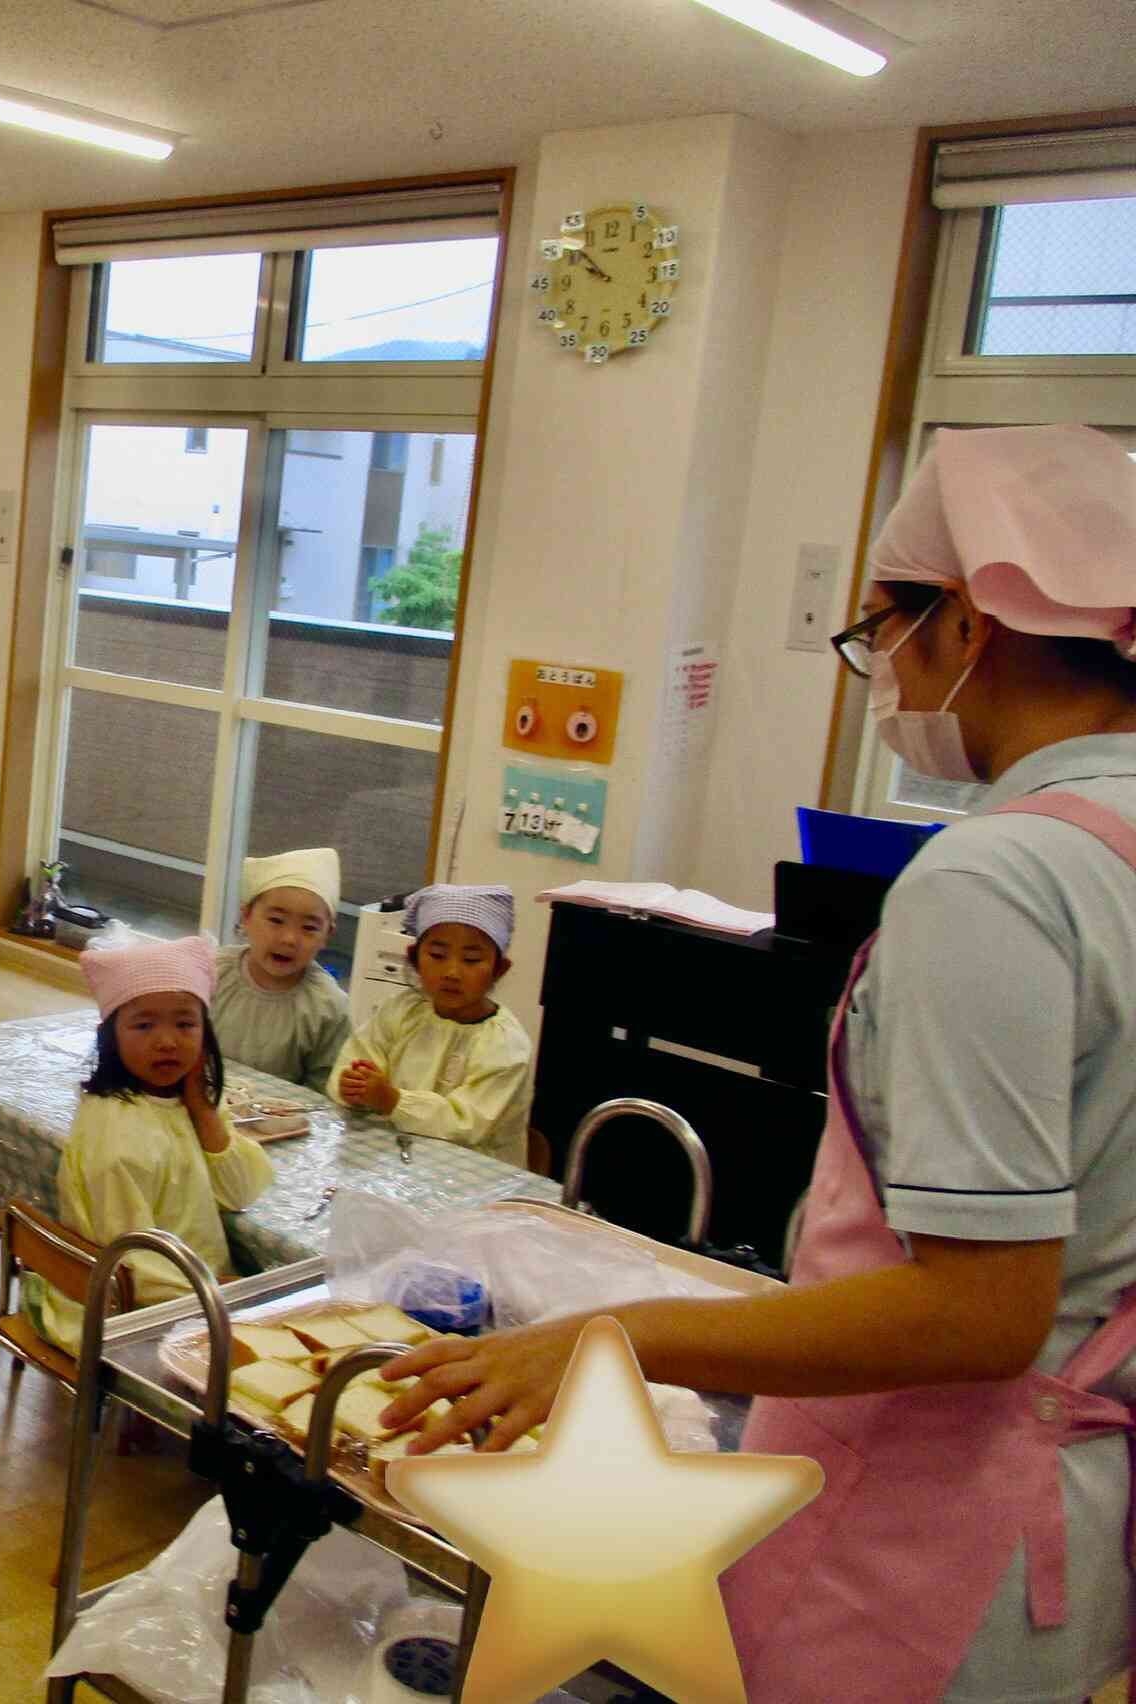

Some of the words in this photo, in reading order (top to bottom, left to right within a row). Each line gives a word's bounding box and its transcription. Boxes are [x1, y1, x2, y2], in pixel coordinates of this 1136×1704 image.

[636, 206, 646, 218] 5
[605, 220, 620, 238] 12
[630, 225, 637, 242] 1
[585, 231, 595, 246] 11
[643, 241, 653, 258] 2
[647, 266, 657, 283] 3
[662, 264, 677, 276] 15
[530, 278, 549, 290] 45
[560, 274, 572, 291] 9
[565, 299, 575, 314] 8
[638, 291, 647, 308] 4
[538, 310, 556, 321] 40
[652, 302, 669, 314] 20
[580, 316, 589, 332] 7
[622, 313, 632, 328] 5
[599, 320, 610, 337] 6
[560, 335, 576, 347] 35
[630, 331, 647, 343] 25
[591, 346, 607, 357] 30
[504, 813, 516, 831] 7
[520, 813, 540, 830] 13
